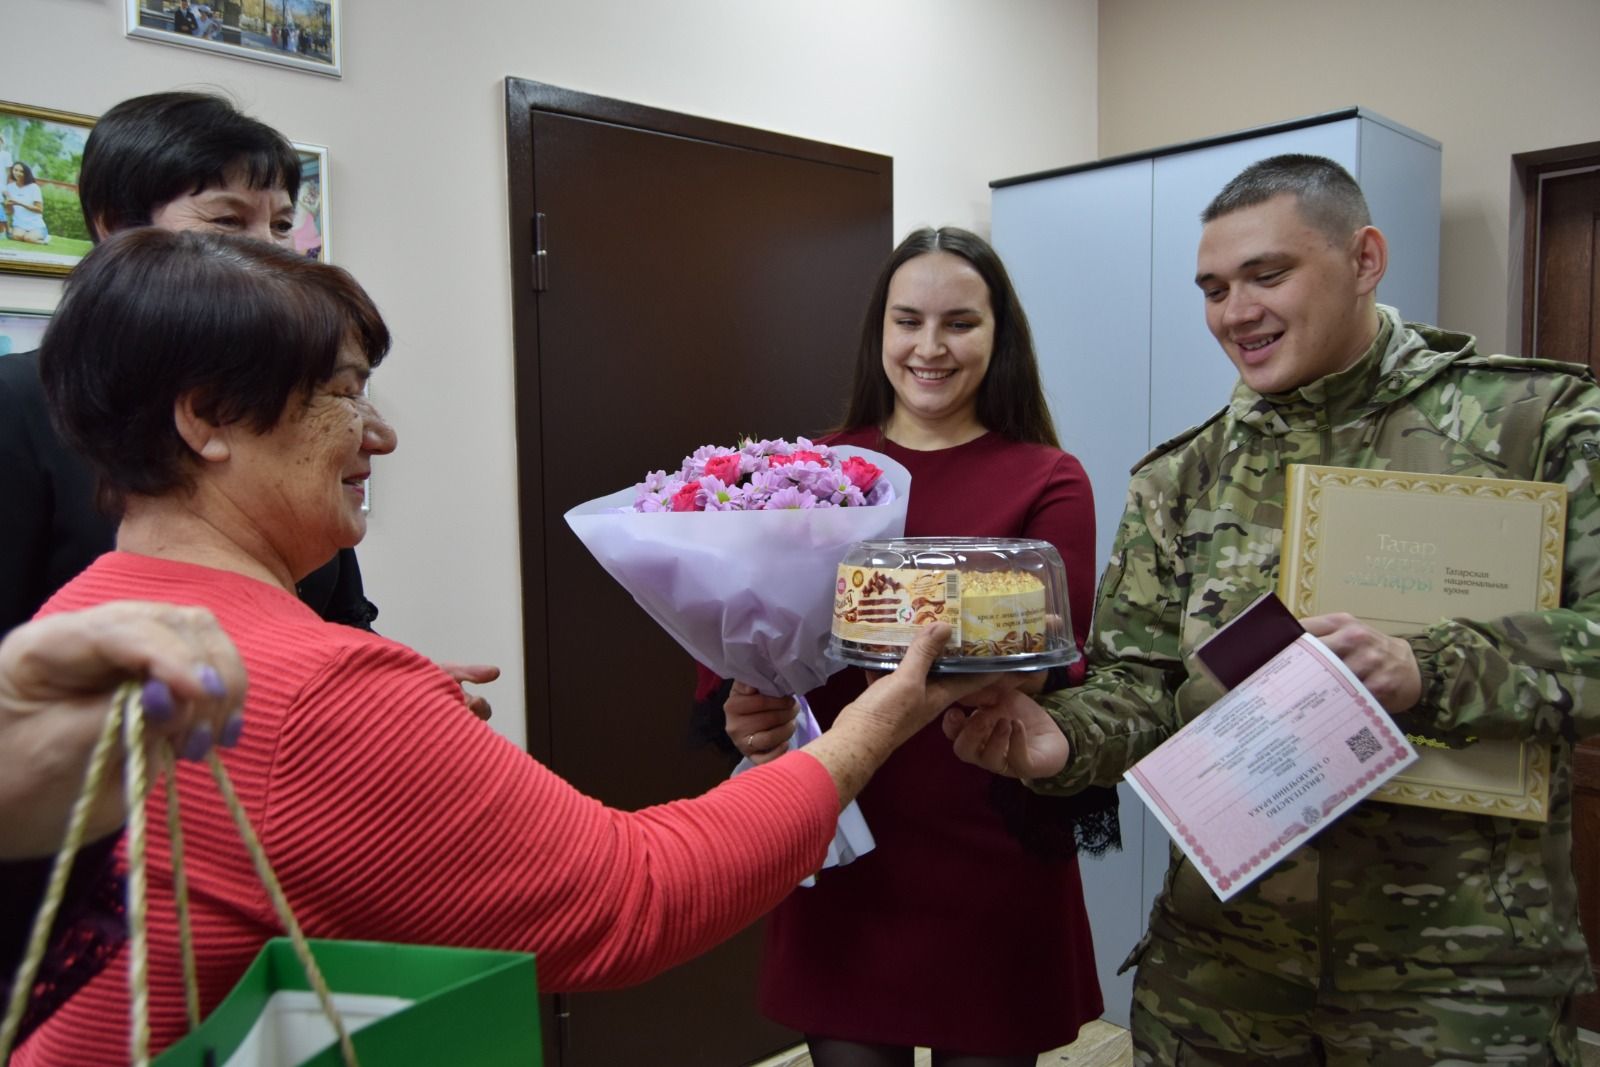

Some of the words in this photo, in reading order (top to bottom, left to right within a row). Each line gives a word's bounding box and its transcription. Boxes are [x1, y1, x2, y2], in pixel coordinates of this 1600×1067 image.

[1377, 533, 1437, 556] Татар
[1443, 577, 1509, 590] национальная
[1445, 567, 1490, 579] Татарская
[1271, 761, 1322, 801] ЗАКЛЮЧЕНИИ
[1264, 771, 1325, 818] СВИДЕТЕЛЬСТВО
[1247, 797, 1272, 818] БРАКА
